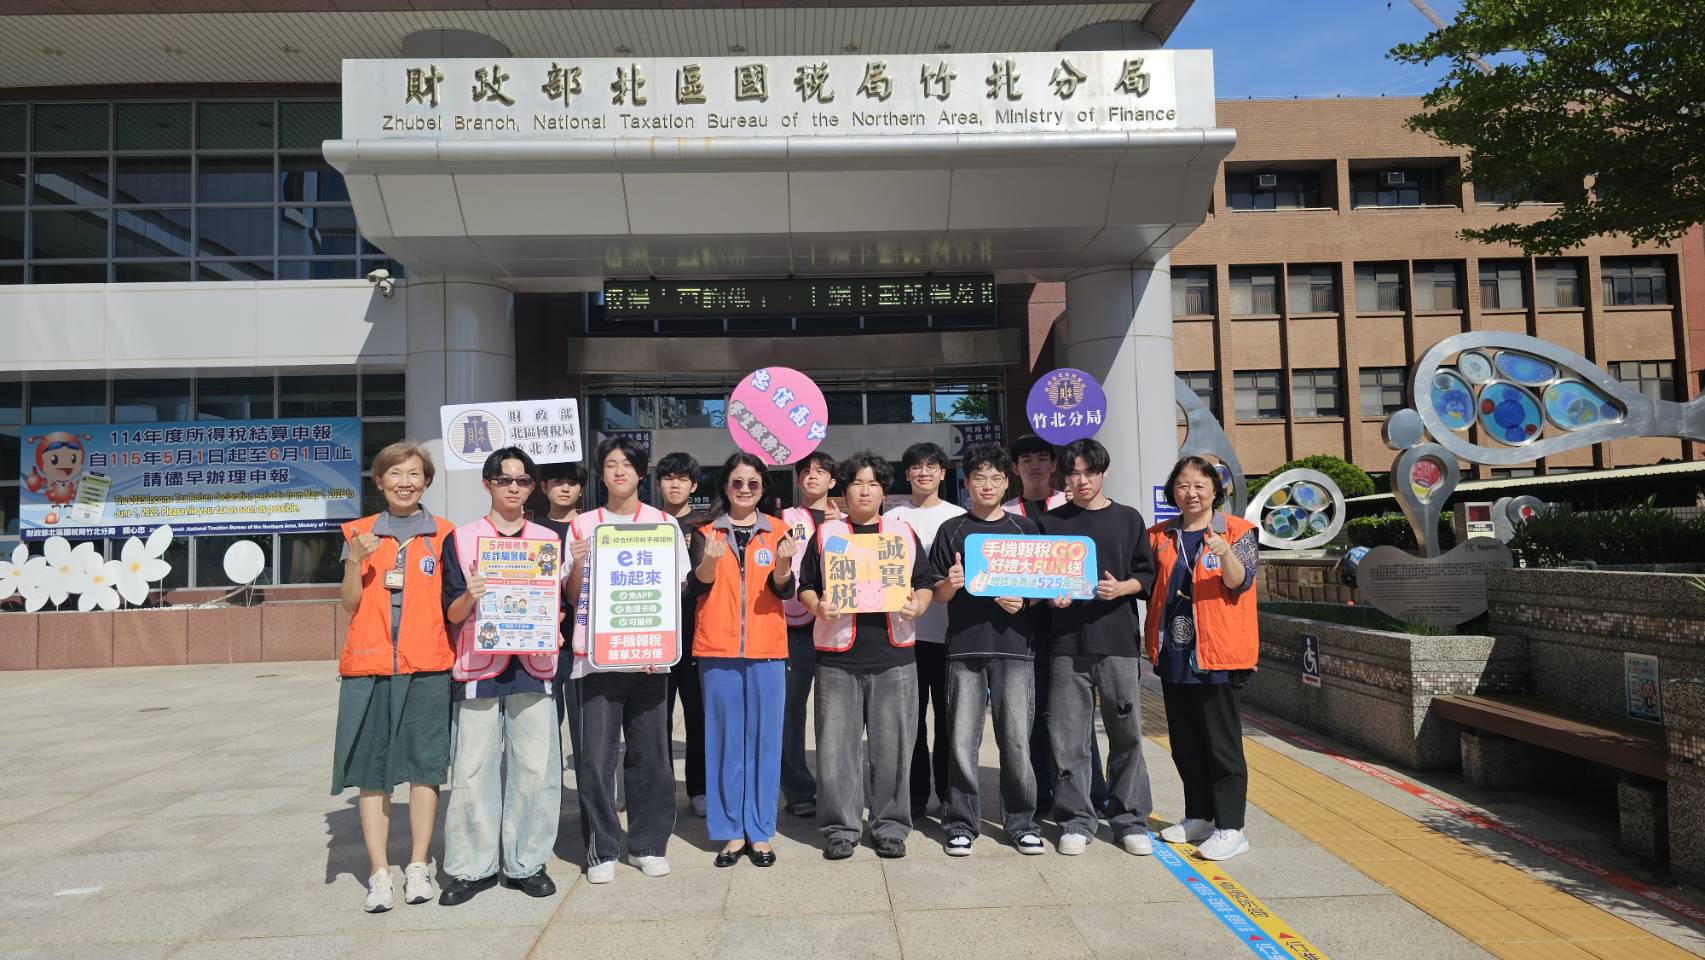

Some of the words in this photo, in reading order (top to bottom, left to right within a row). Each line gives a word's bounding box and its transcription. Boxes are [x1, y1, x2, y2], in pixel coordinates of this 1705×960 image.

[405, 57, 1152, 108] 財政部北區國稅局竹北分局
[382, 115, 442, 130] Zhubei
[455, 115, 520, 132] Branch,
[534, 114, 606, 129] National
[620, 113, 694, 129] Taxation
[708, 113, 768, 128] Bureau
[781, 113, 799, 128] of
[812, 112, 839, 127] the
[853, 111, 925, 126] Northern
[938, 110, 983, 126] Area,
[995, 108, 1063, 127] Ministry
[1077, 107, 1095, 122] of
[1109, 106, 1176, 121] Finance
[508, 408, 573, 423] 財政部
[1033, 410, 1102, 429] 竹北分局
[111, 425, 332, 445] 114年度所得稅結算申報
[511, 424, 575, 439] 北區國稅局
[89, 444, 353, 467] 自115年5月1日起至6月1日止
[143, 468, 290, 487] 請儘早辦理申報
[617, 550, 653, 566] e指
[983, 540, 1086, 560] 手機報稅GO
[878, 536, 906, 588] 誠實
[990, 559, 1084, 576] 好禮大FUN送
[610, 570, 661, 586] 動起來
[829, 556, 858, 609] 納稅
[629, 591, 653, 600] 免APP
[609, 634, 662, 648] 手機報稅
[608, 648, 663, 661] 簡單又方便
